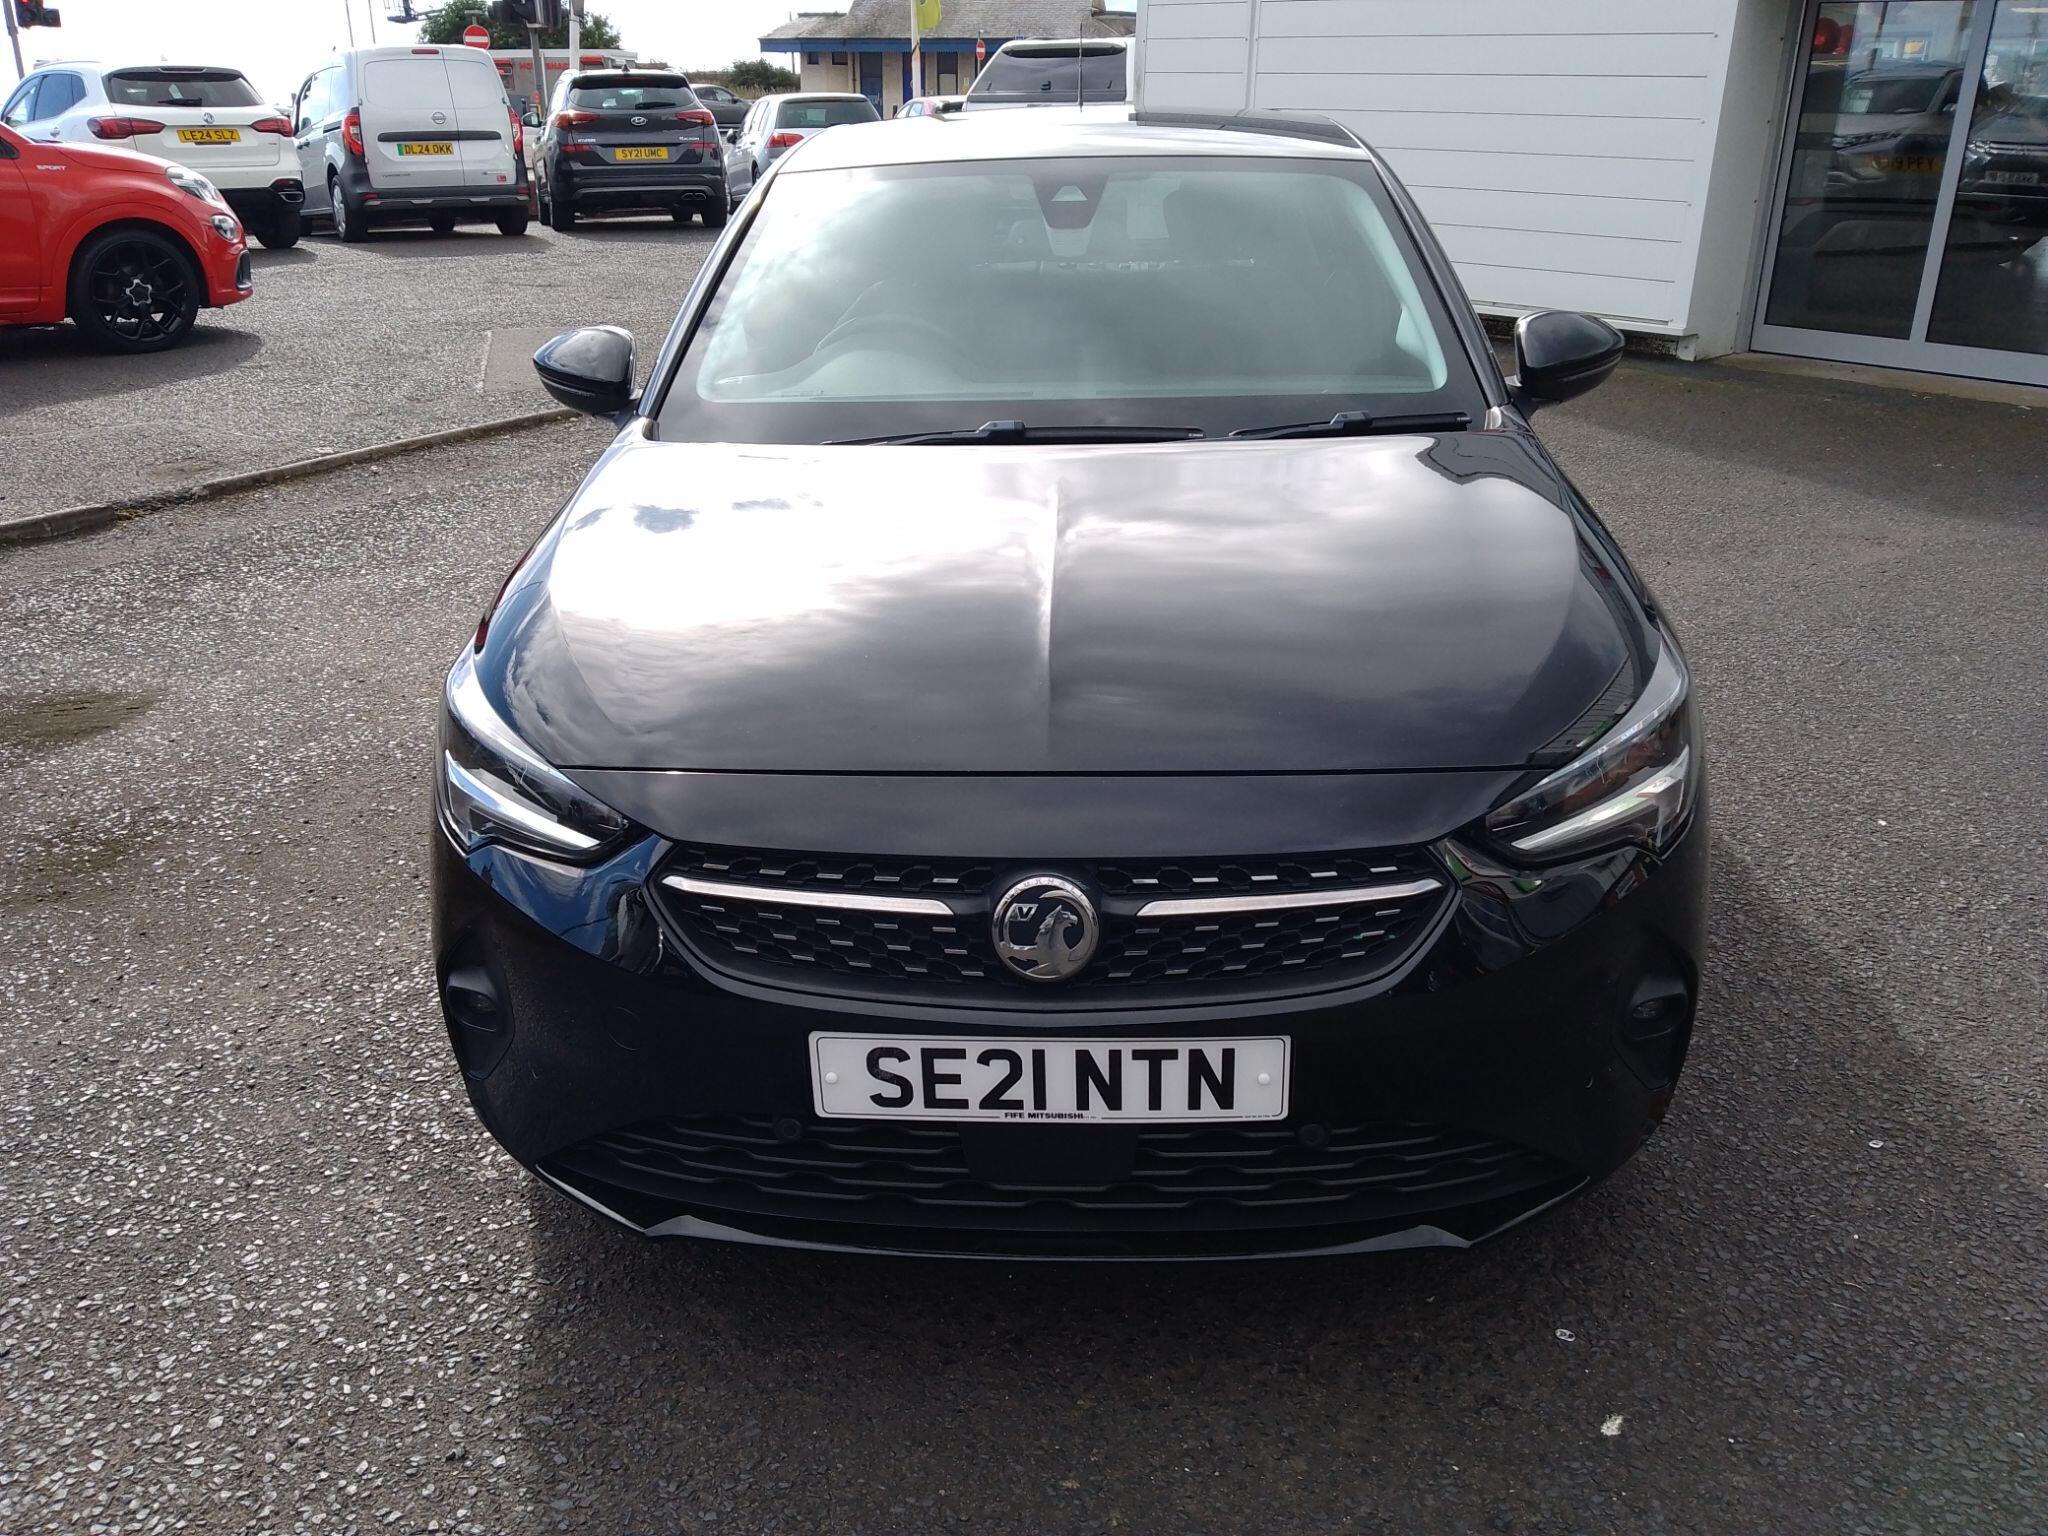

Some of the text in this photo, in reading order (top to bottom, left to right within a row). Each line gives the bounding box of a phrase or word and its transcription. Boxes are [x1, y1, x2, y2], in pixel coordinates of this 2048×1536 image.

[182, 130, 237, 141] LE24 SLZ
[404, 144, 430, 155] DL24
[621, 149, 663, 158] SY21 UMC
[865, 1046, 1236, 1111] SE21 NTN
